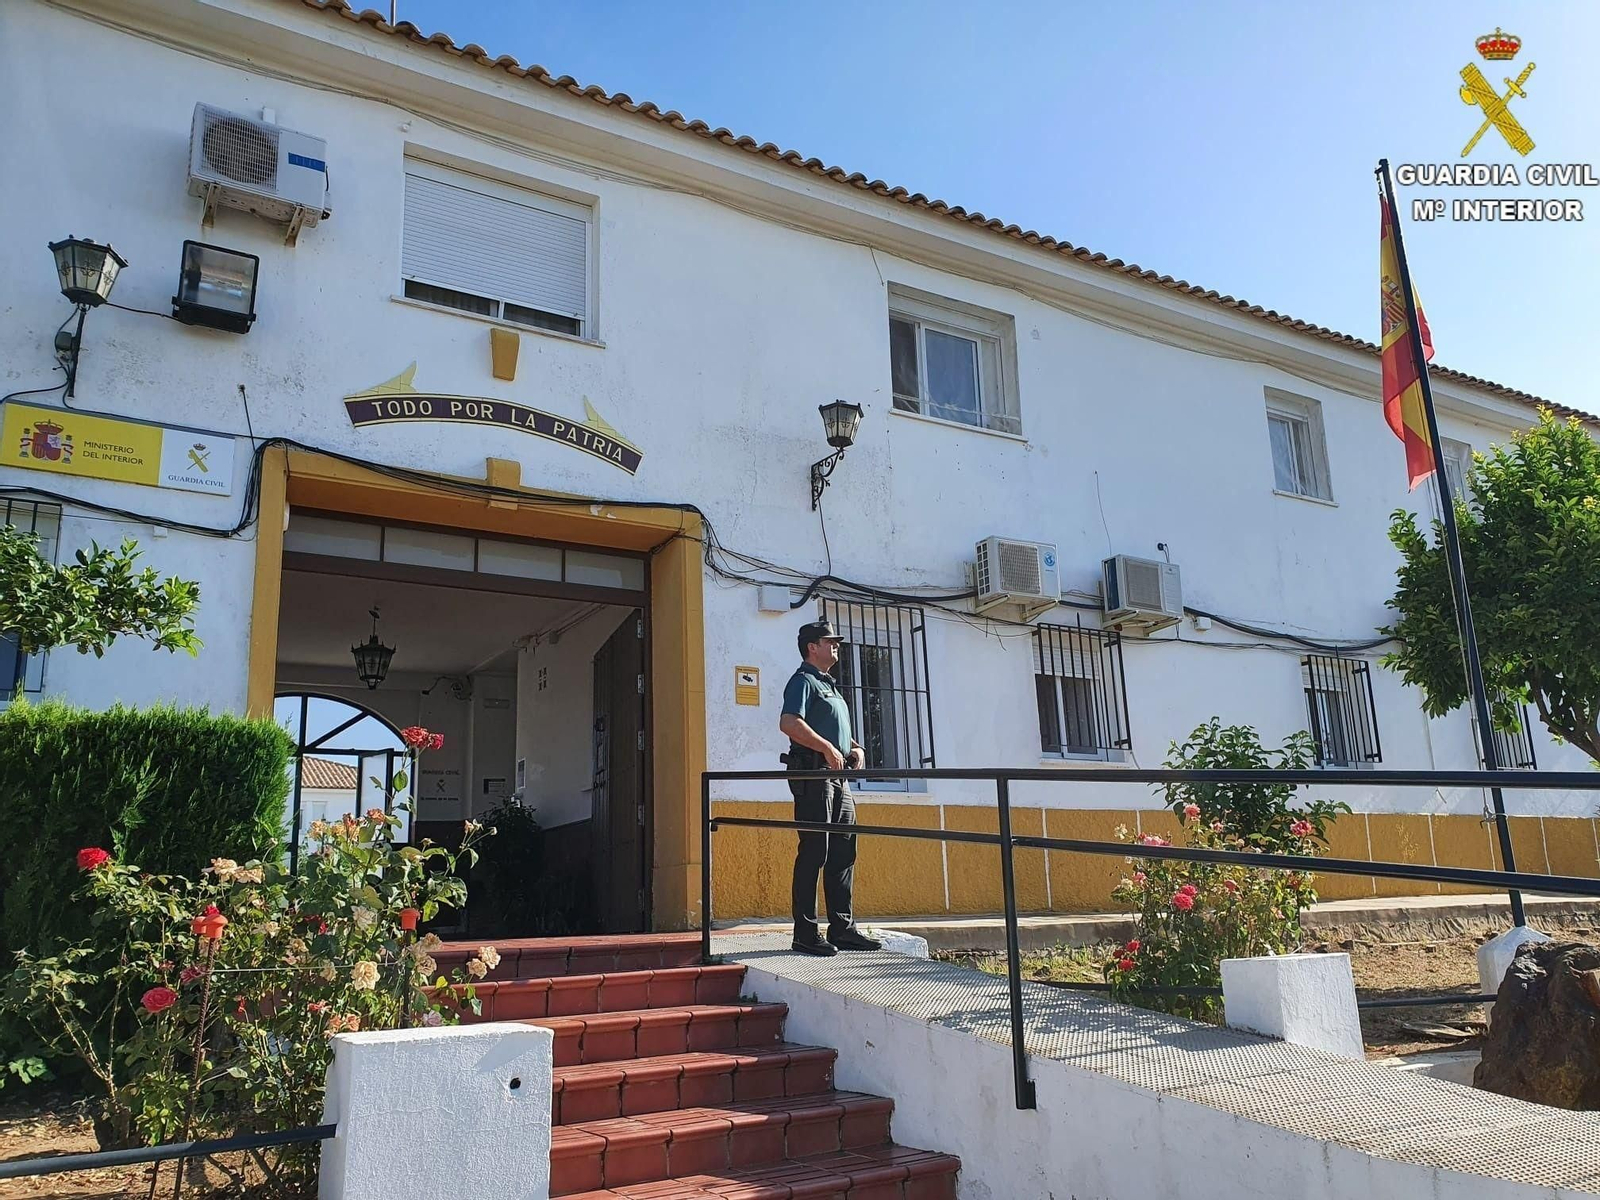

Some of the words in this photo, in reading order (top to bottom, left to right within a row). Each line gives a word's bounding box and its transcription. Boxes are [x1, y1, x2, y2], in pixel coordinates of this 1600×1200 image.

[371, 400, 433, 417] TODO
[450, 402, 494, 420] POR
[511, 408, 537, 429] LA
[553, 421, 623, 462] PATRIA
[83, 440, 134, 454] MINISTERIO
[82, 450, 100, 460] DEL
[102, 454, 144, 466] INTERIOR
[167, 474, 204, 485] GUARDIA
[205, 479, 226, 488] CIVIL
